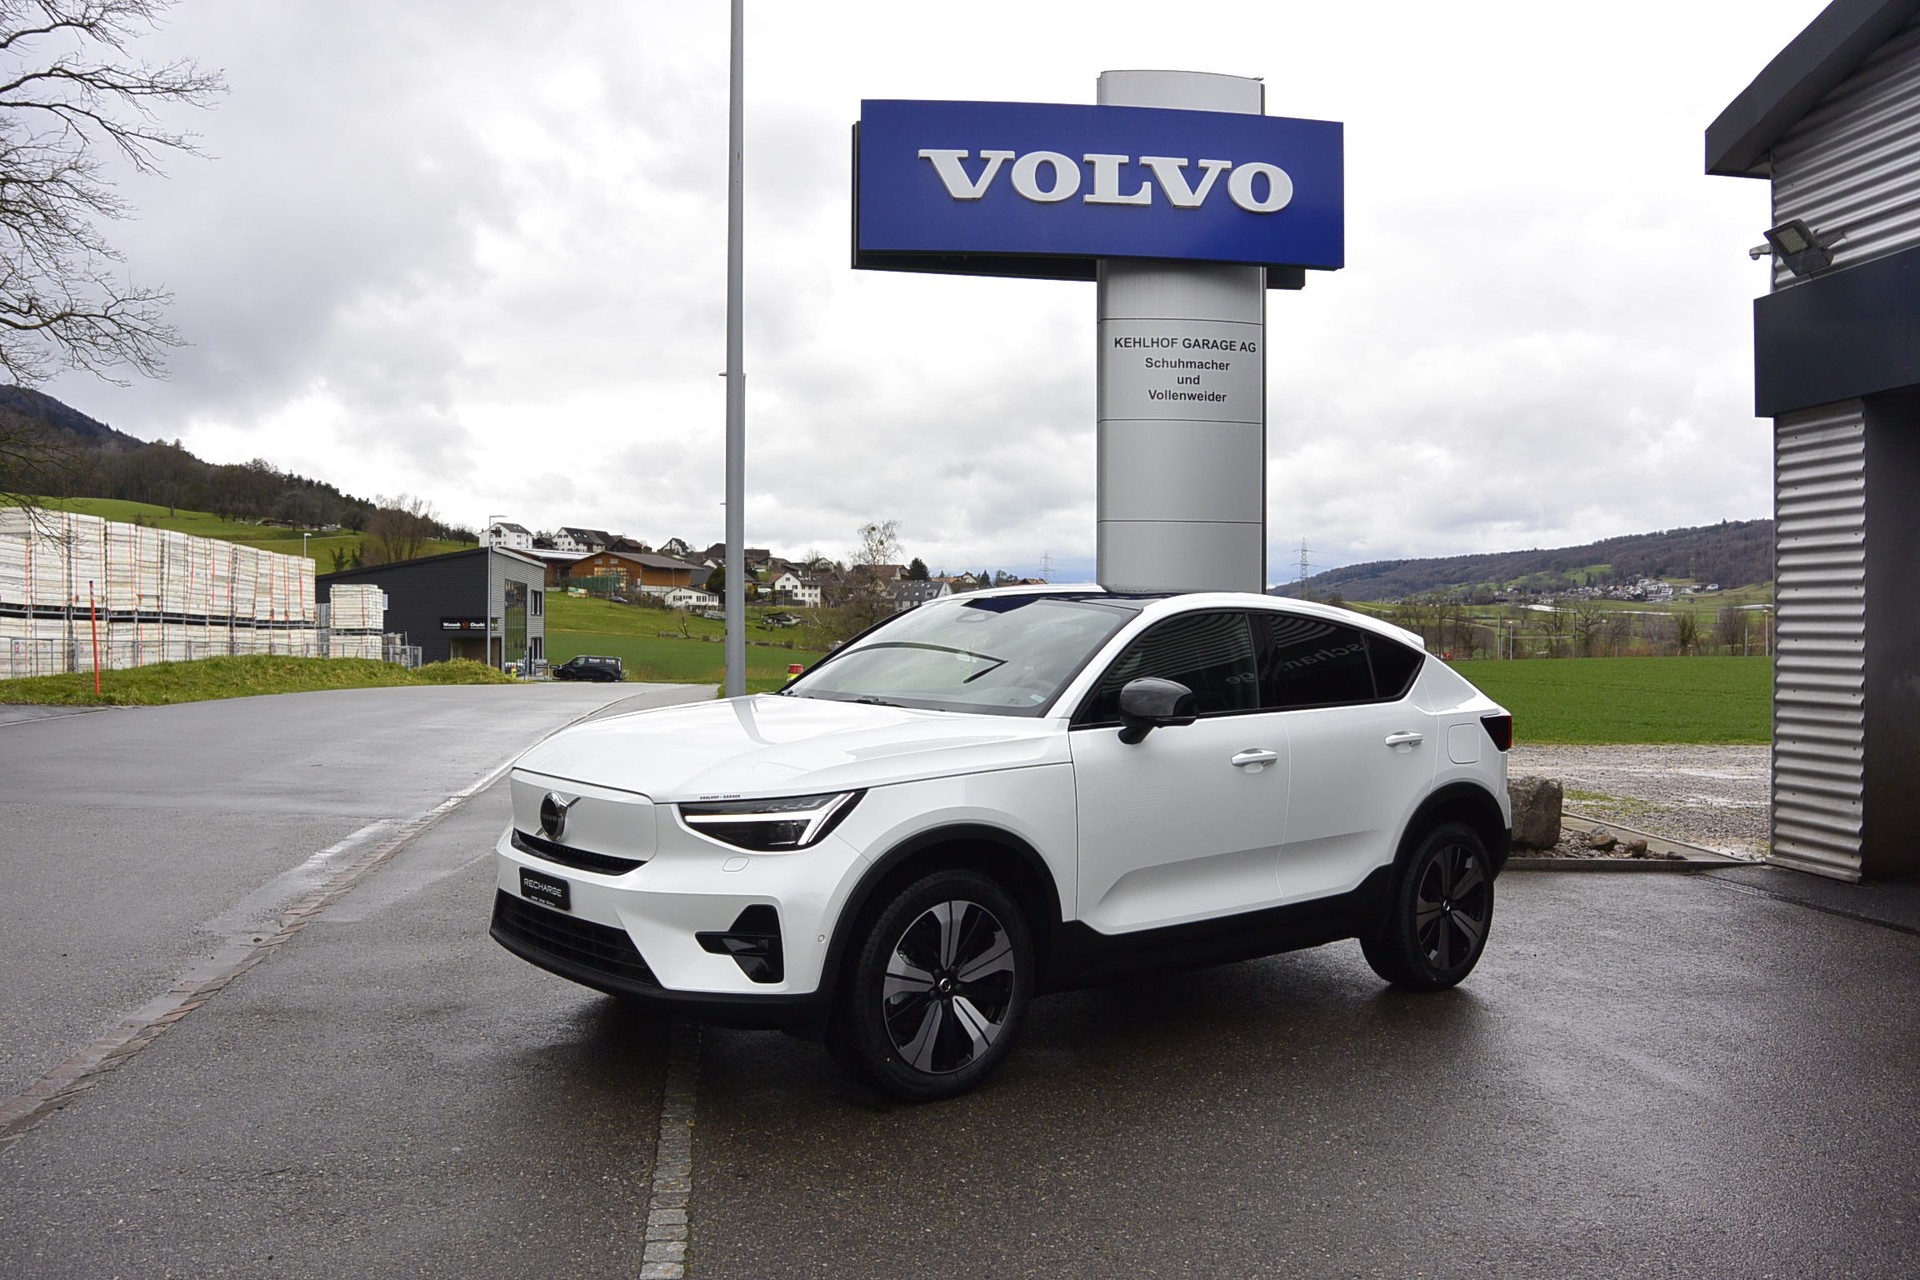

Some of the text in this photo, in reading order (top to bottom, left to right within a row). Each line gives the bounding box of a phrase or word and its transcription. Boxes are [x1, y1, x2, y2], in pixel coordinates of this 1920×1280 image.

[918, 149, 1293, 213] VOLVO
[1114, 337, 1257, 353] KEHLHOF GARAGE AG
[1145, 357, 1230, 371] Schuhmacher
[1177, 374, 1200, 385] und
[1148, 389, 1228, 403] Vollenweider
[523, 878, 562, 898] RECHARGE
